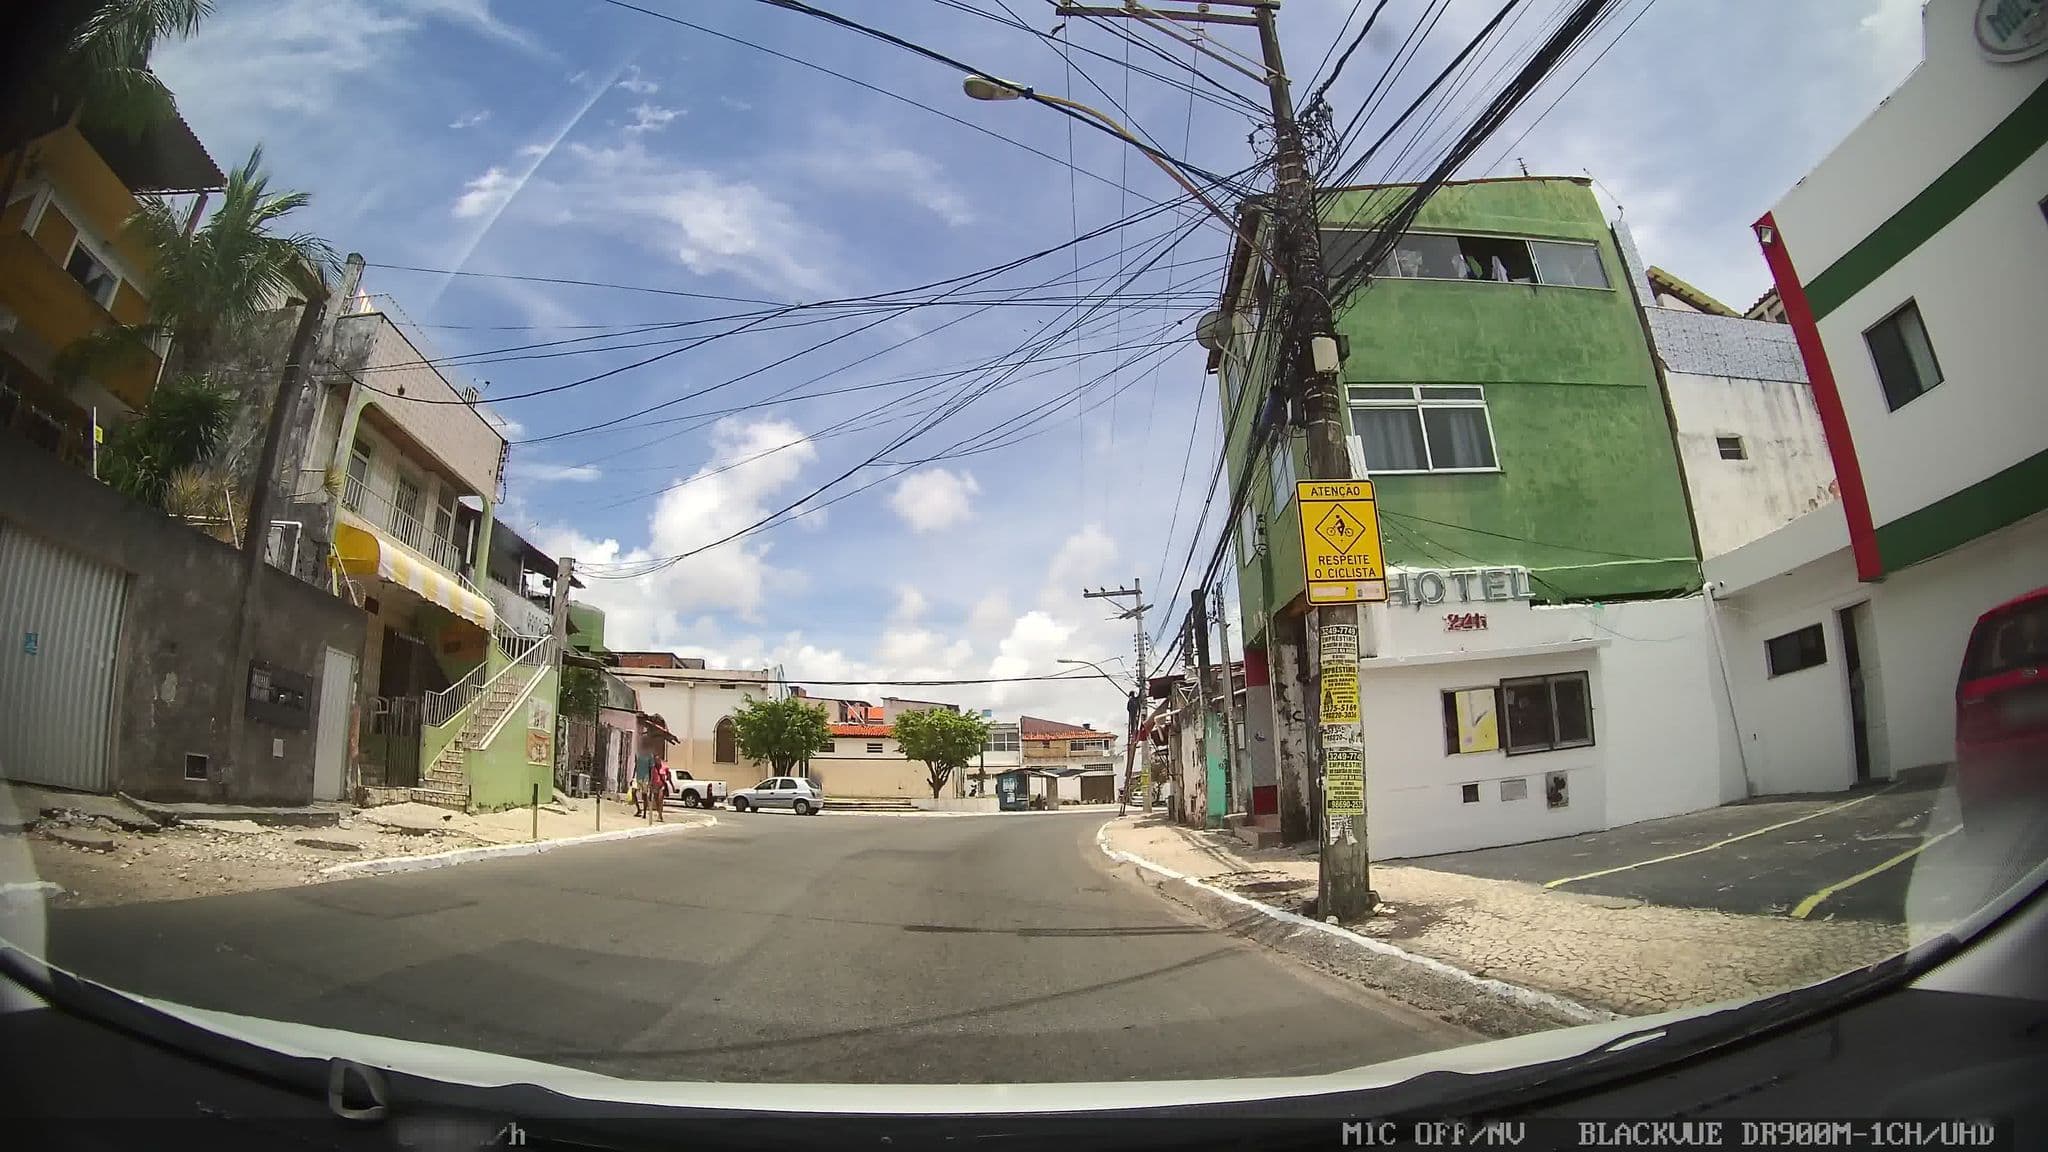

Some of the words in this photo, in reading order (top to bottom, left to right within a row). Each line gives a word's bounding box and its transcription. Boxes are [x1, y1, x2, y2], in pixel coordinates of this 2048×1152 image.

[1311, 484, 1360, 497] ATENÇÃO
[1318, 555, 1370, 565] RESPEITE
[1315, 568, 1322, 578] O
[1328, 567, 1376, 578] CICLISTA
[1387, 568, 1536, 608] HOTEL
